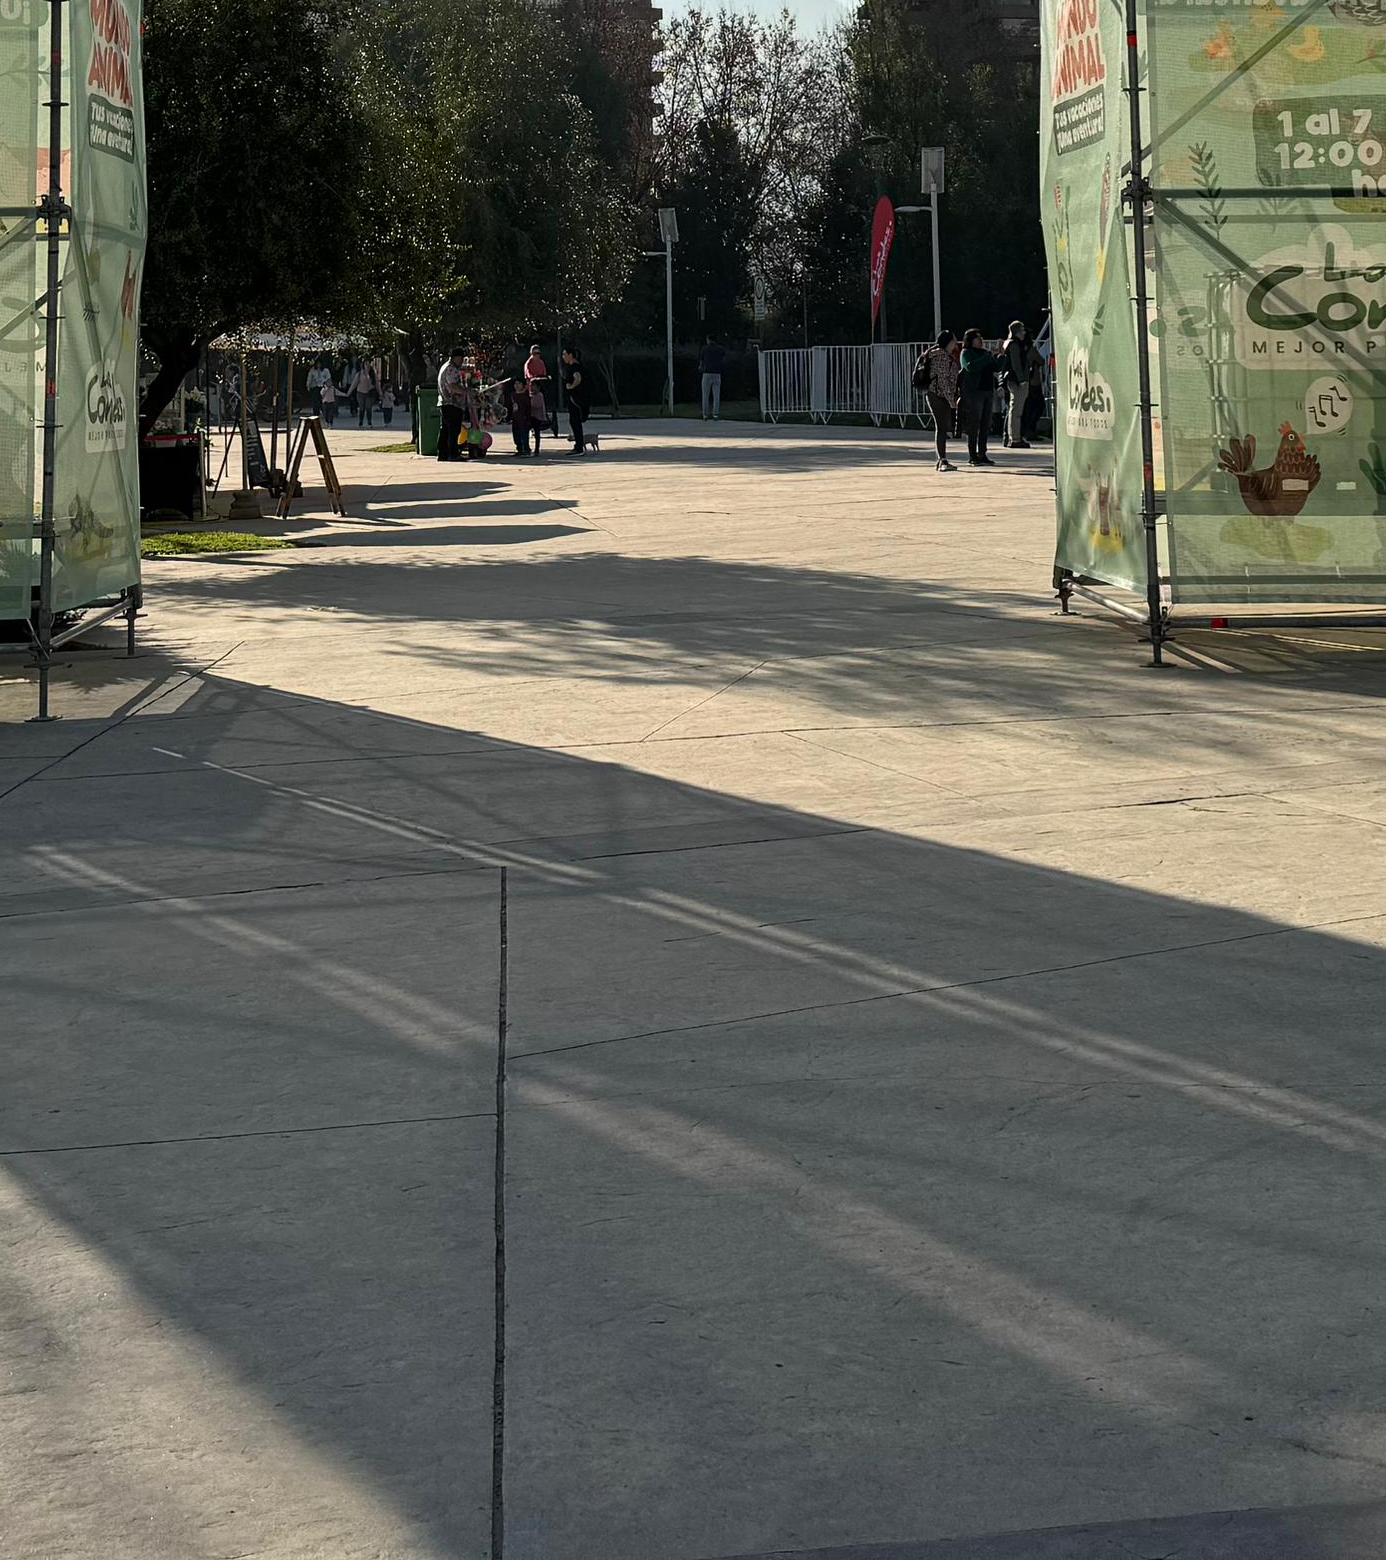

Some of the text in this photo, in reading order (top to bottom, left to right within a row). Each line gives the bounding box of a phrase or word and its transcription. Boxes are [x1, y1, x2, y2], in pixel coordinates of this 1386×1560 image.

[1277, 110, 1293, 137] 1
[1305, 108, 1340, 136] al
[1352, 108, 1373, 134] 7
[1274, 139, 1383, 169] 12:00
[1251, 339, 1346, 354] MEJOR
